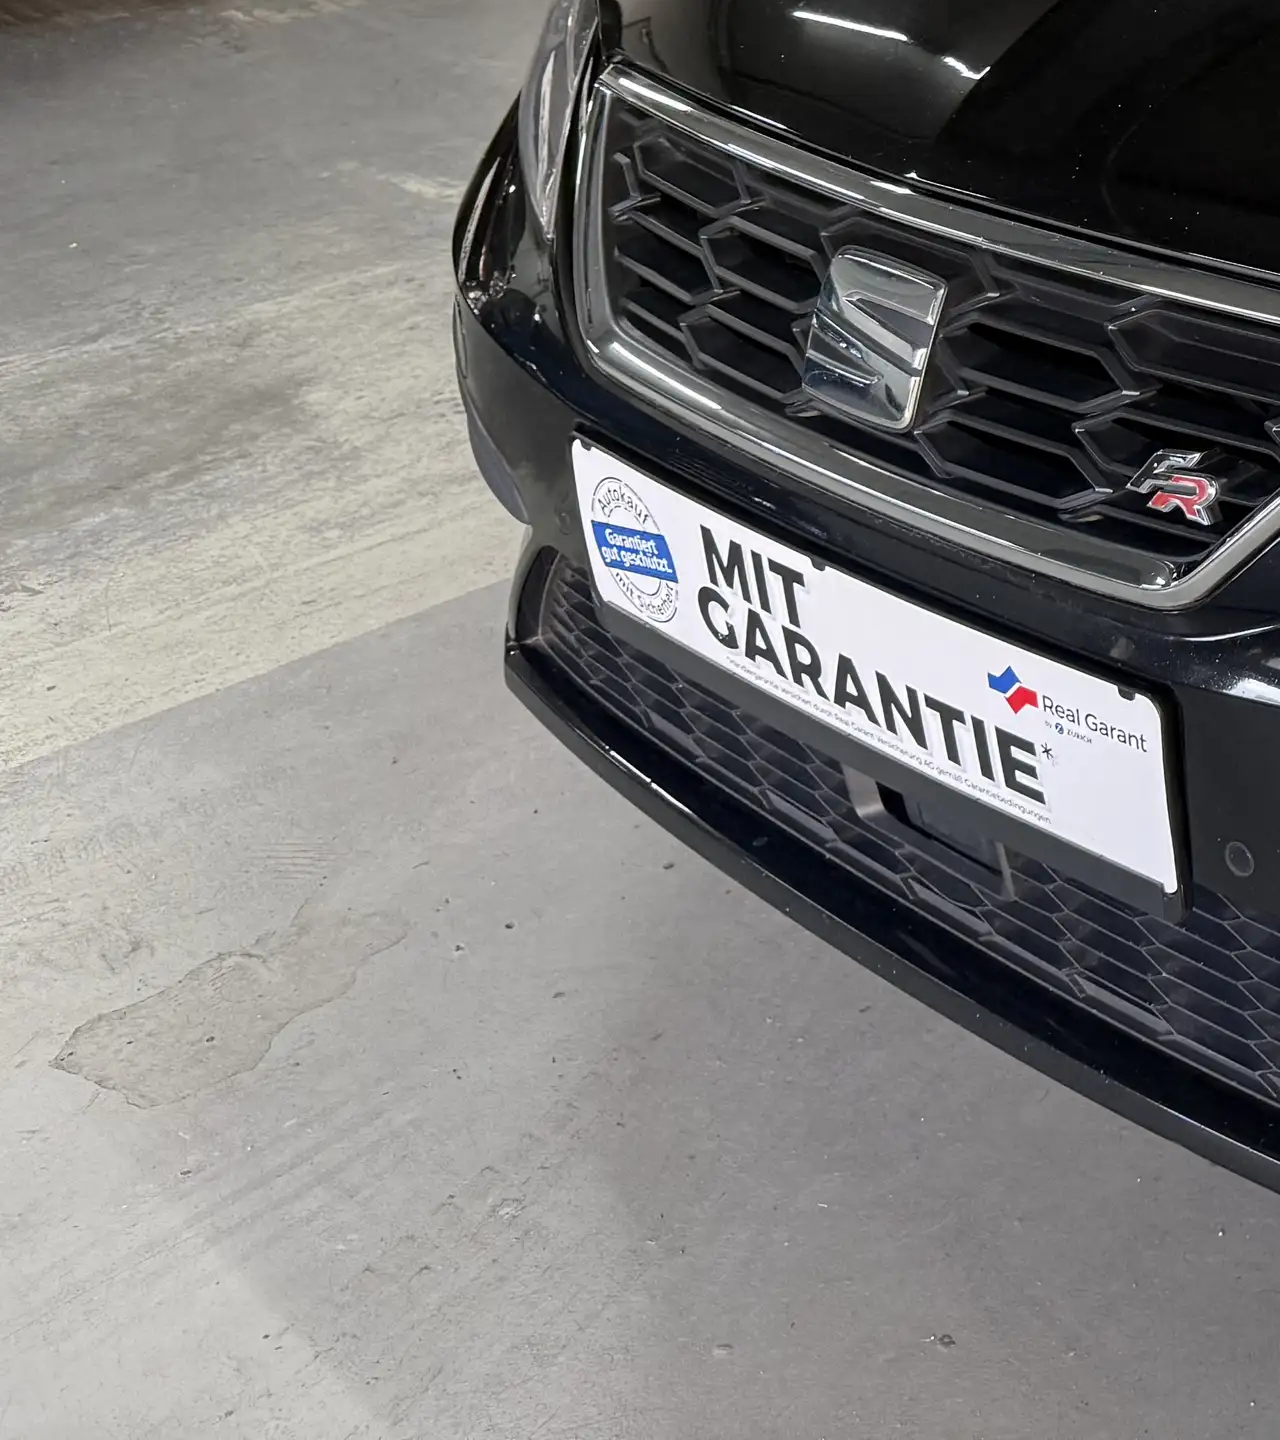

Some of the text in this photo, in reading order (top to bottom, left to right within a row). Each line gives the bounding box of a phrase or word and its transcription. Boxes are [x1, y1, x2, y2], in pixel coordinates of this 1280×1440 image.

[598, 484, 649, 525] Autokauf
[1126, 448, 1219, 526] FR
[601, 546, 620, 563] gut
[604, 528, 658, 556] Garantiert
[615, 571, 674, 616] mit Sicherheit
[700, 524, 805, 629] MIT
[1042, 694, 1148, 753] Real Garant
